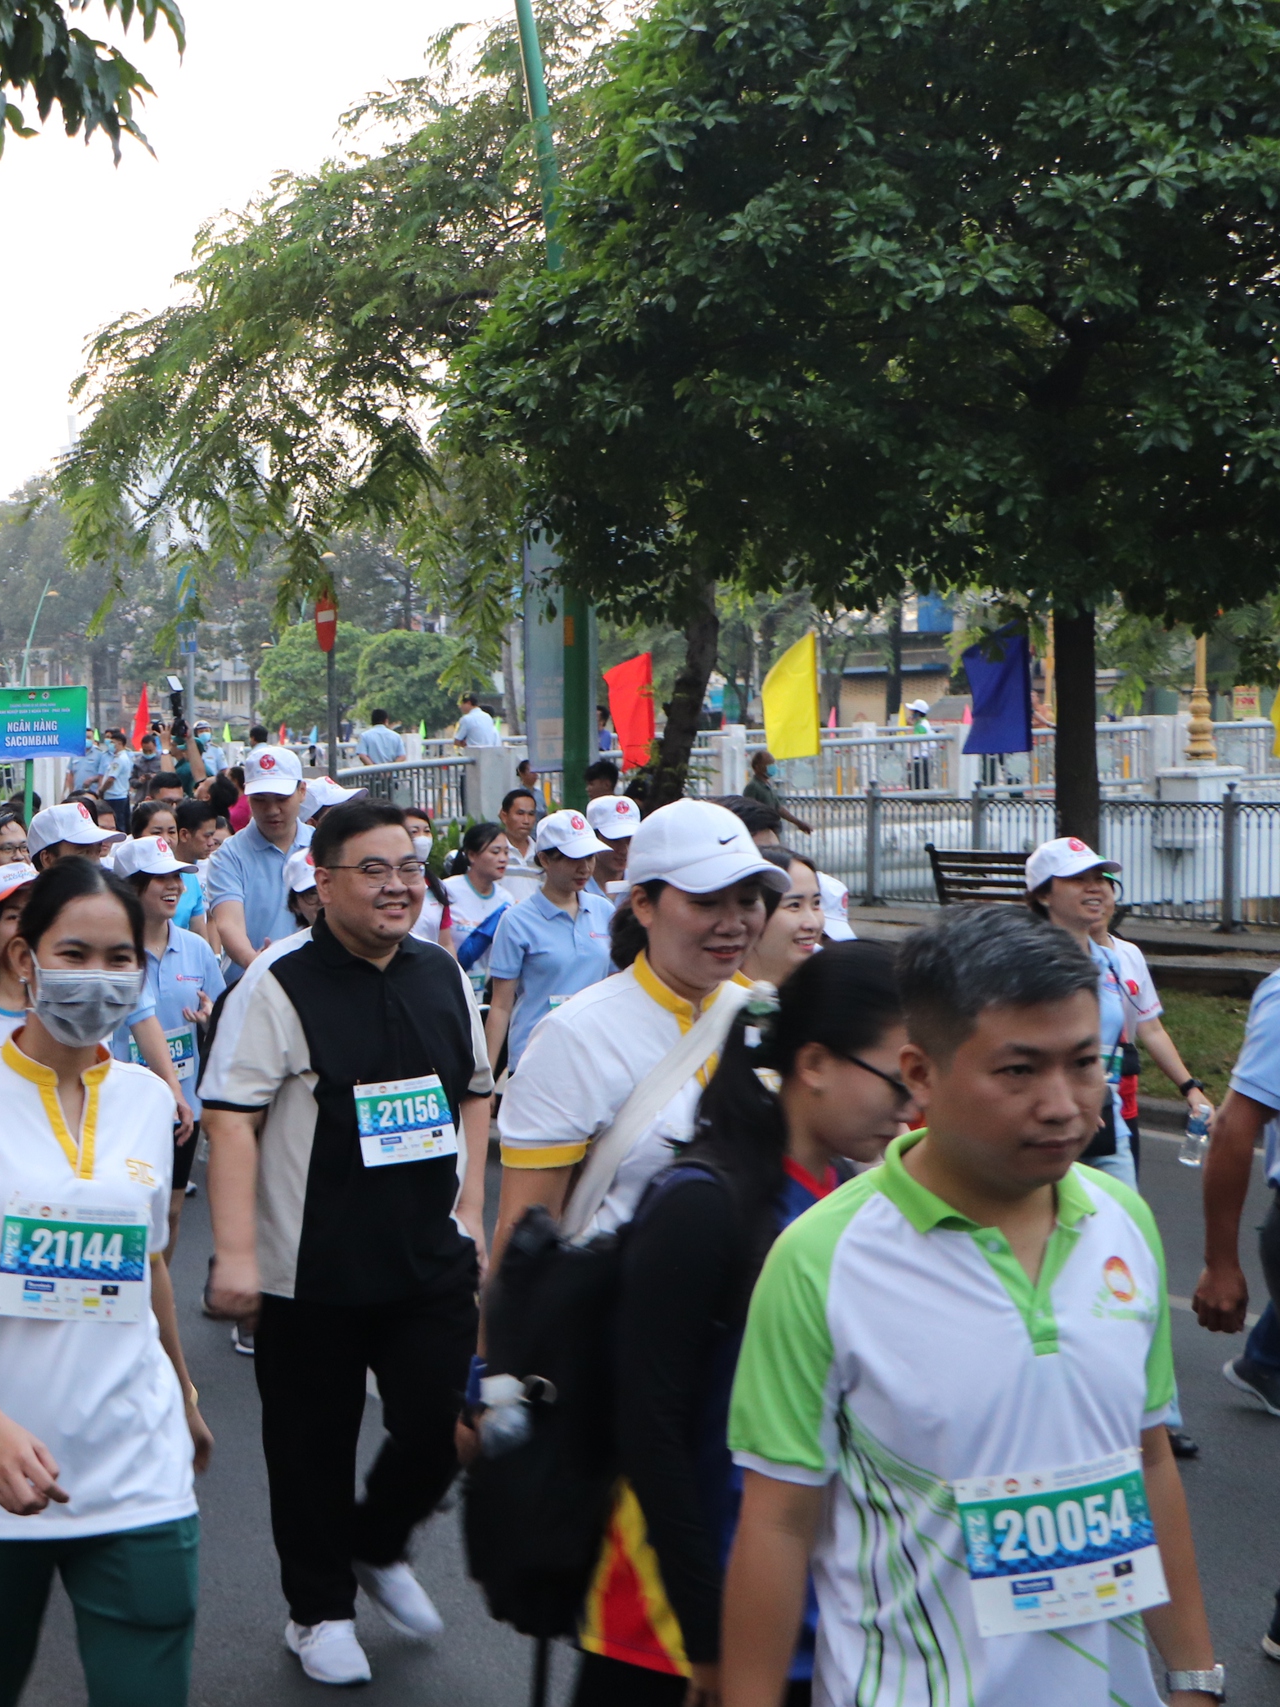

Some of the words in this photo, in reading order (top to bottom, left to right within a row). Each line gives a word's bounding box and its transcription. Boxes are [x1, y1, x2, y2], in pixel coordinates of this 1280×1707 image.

[5, 735, 59, 747] SACOMBANK
[7, 719, 31, 733] NGÂN
[33, 718, 58, 732] HÀNG
[376, 1093, 441, 1127] 21156
[28, 1227, 124, 1271] 21144
[993, 1488, 1132, 1562] 20054
